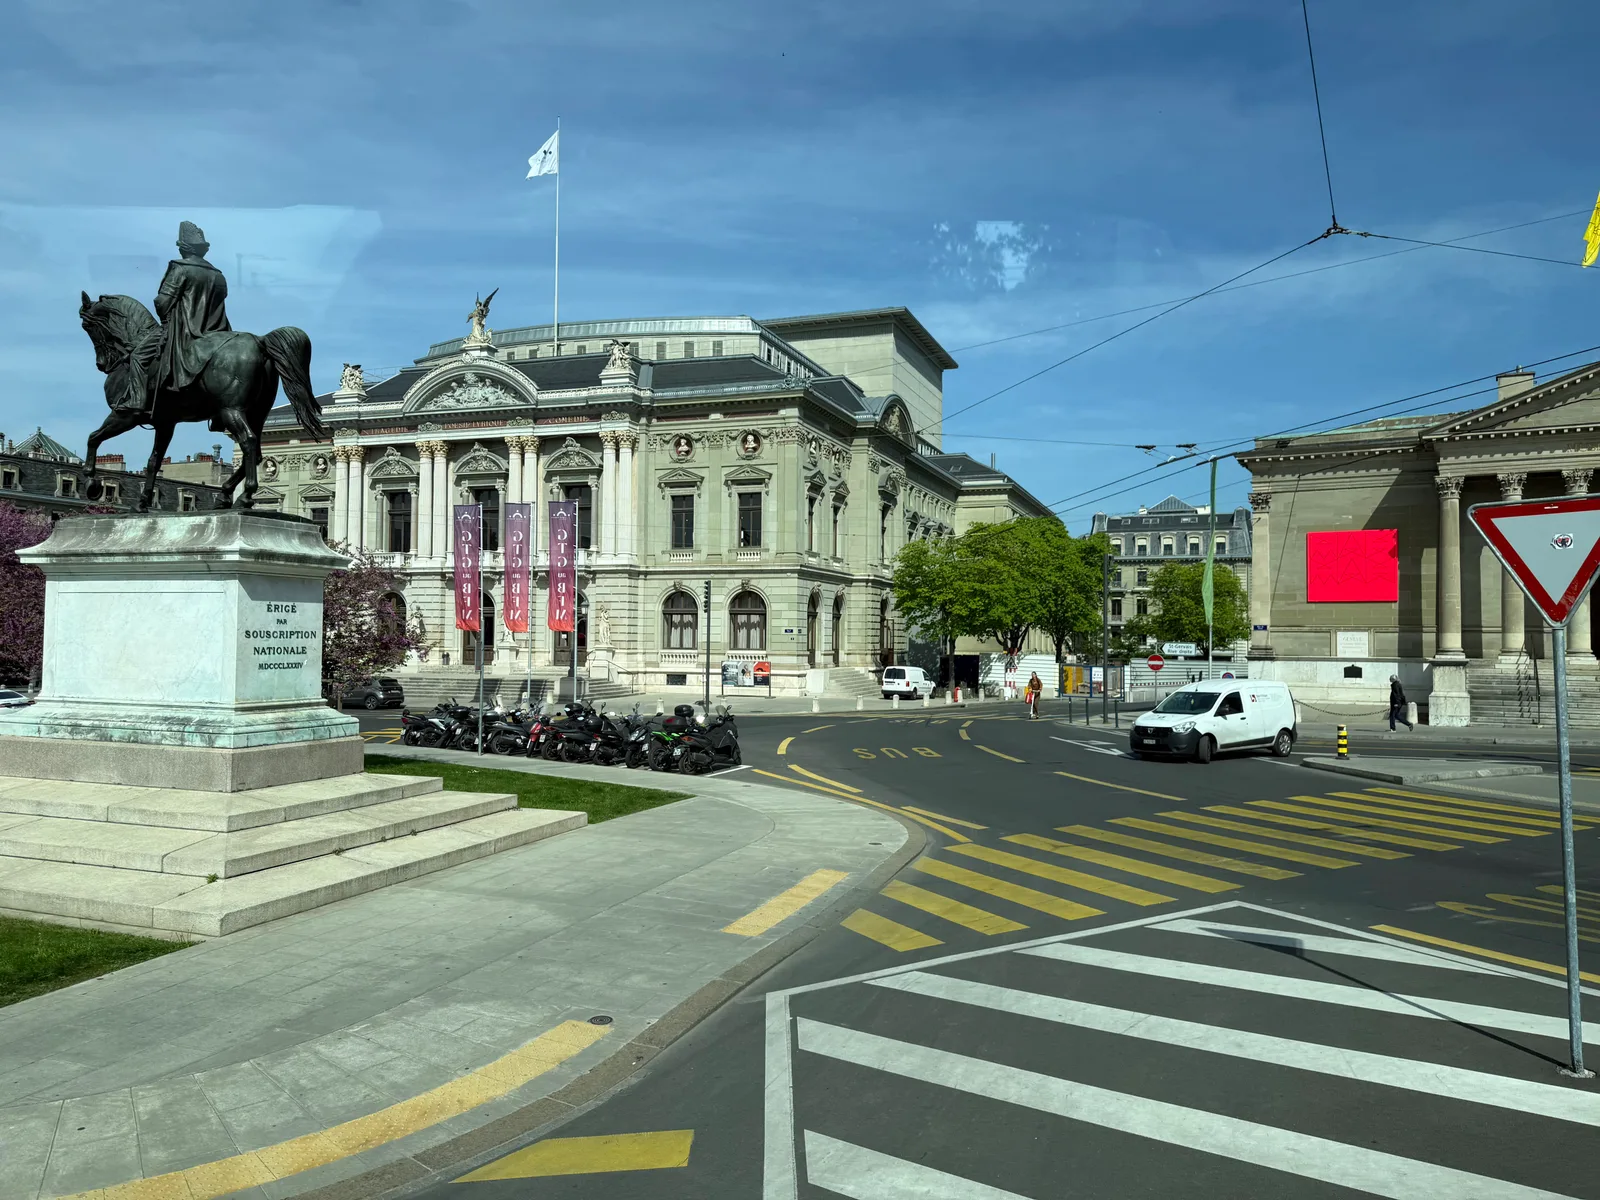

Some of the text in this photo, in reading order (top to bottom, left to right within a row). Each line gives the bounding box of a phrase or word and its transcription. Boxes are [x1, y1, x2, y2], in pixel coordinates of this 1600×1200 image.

[266, 601, 297, 613] ÉRIGÉ
[244, 630, 317, 639] SOUSCRIPTION
[253, 646, 307, 656] NATIONALE
[852, 747, 943, 759] BUS
